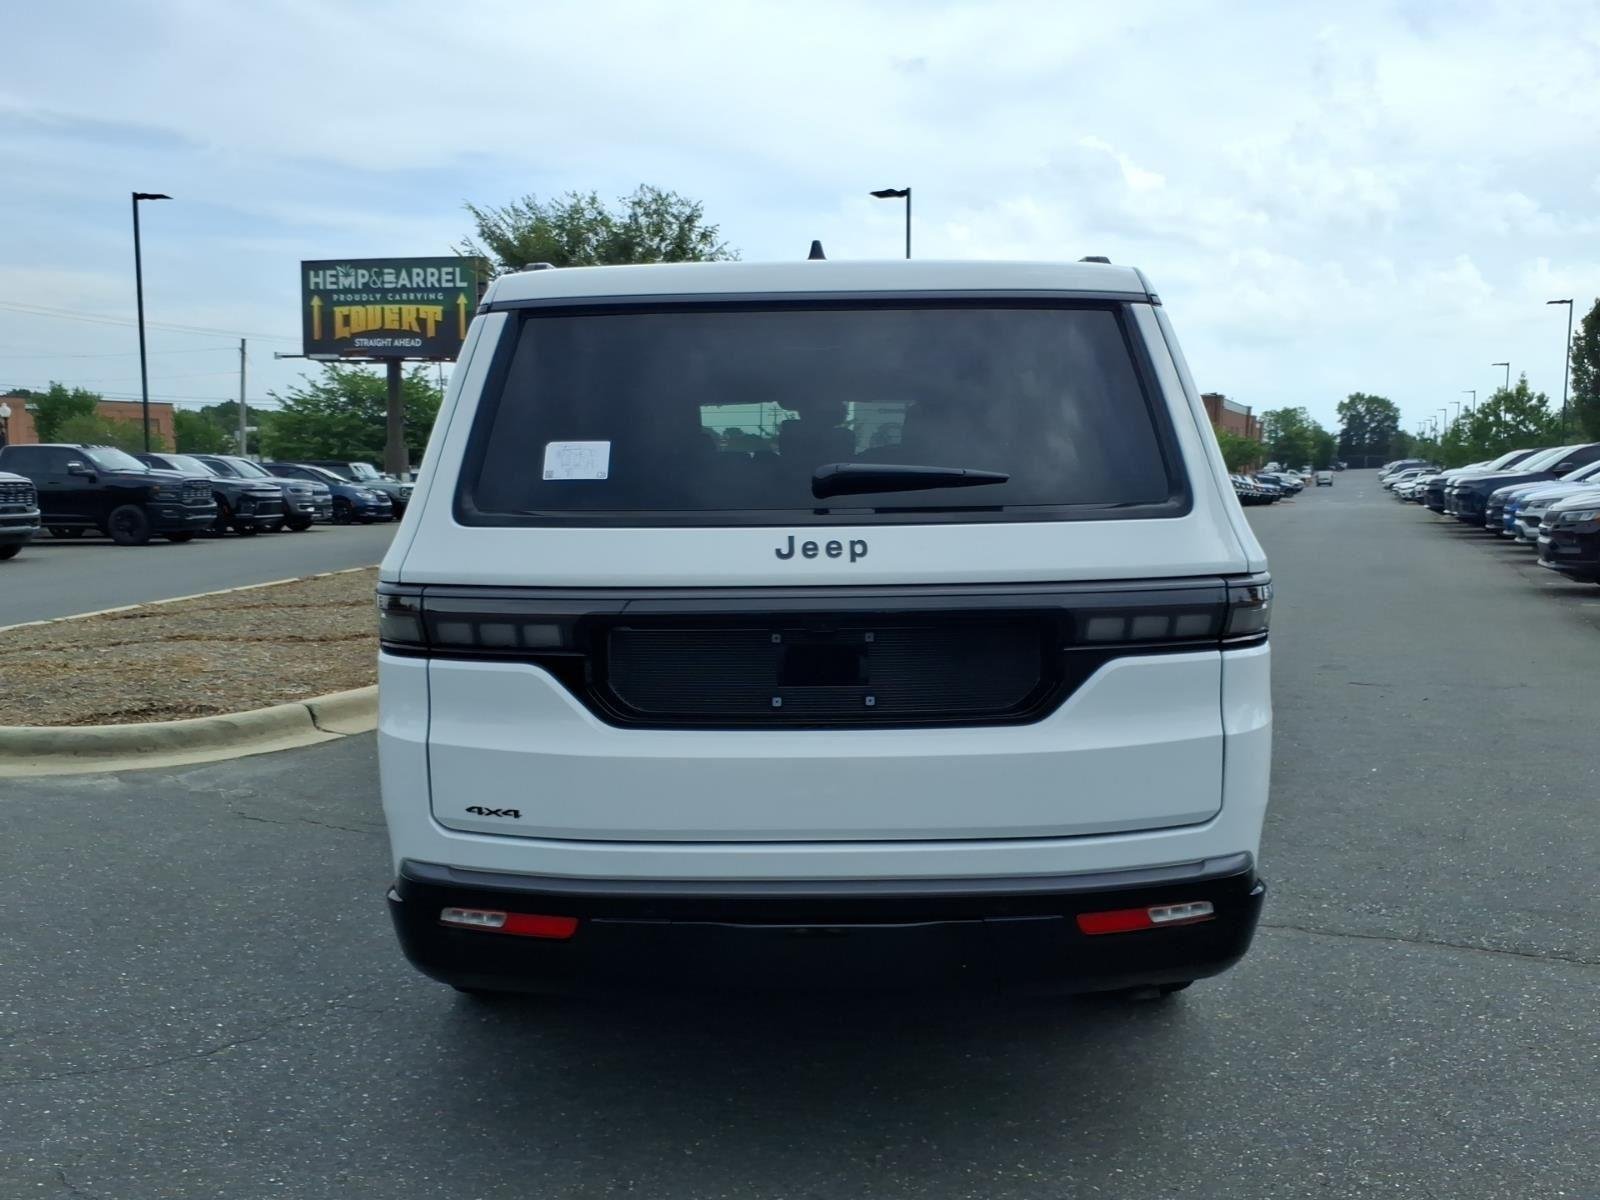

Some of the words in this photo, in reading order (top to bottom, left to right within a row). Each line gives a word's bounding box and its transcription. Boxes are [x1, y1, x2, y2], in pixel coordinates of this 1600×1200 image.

[333, 293, 381, 301] PROUDLY
[387, 292, 444, 301] CARRYING
[333, 304, 443, 339] COVERT
[354, 338, 392, 347] STRAIGHT
[393, 338, 422, 346] AHEAD
[775, 535, 868, 563] Jeep
